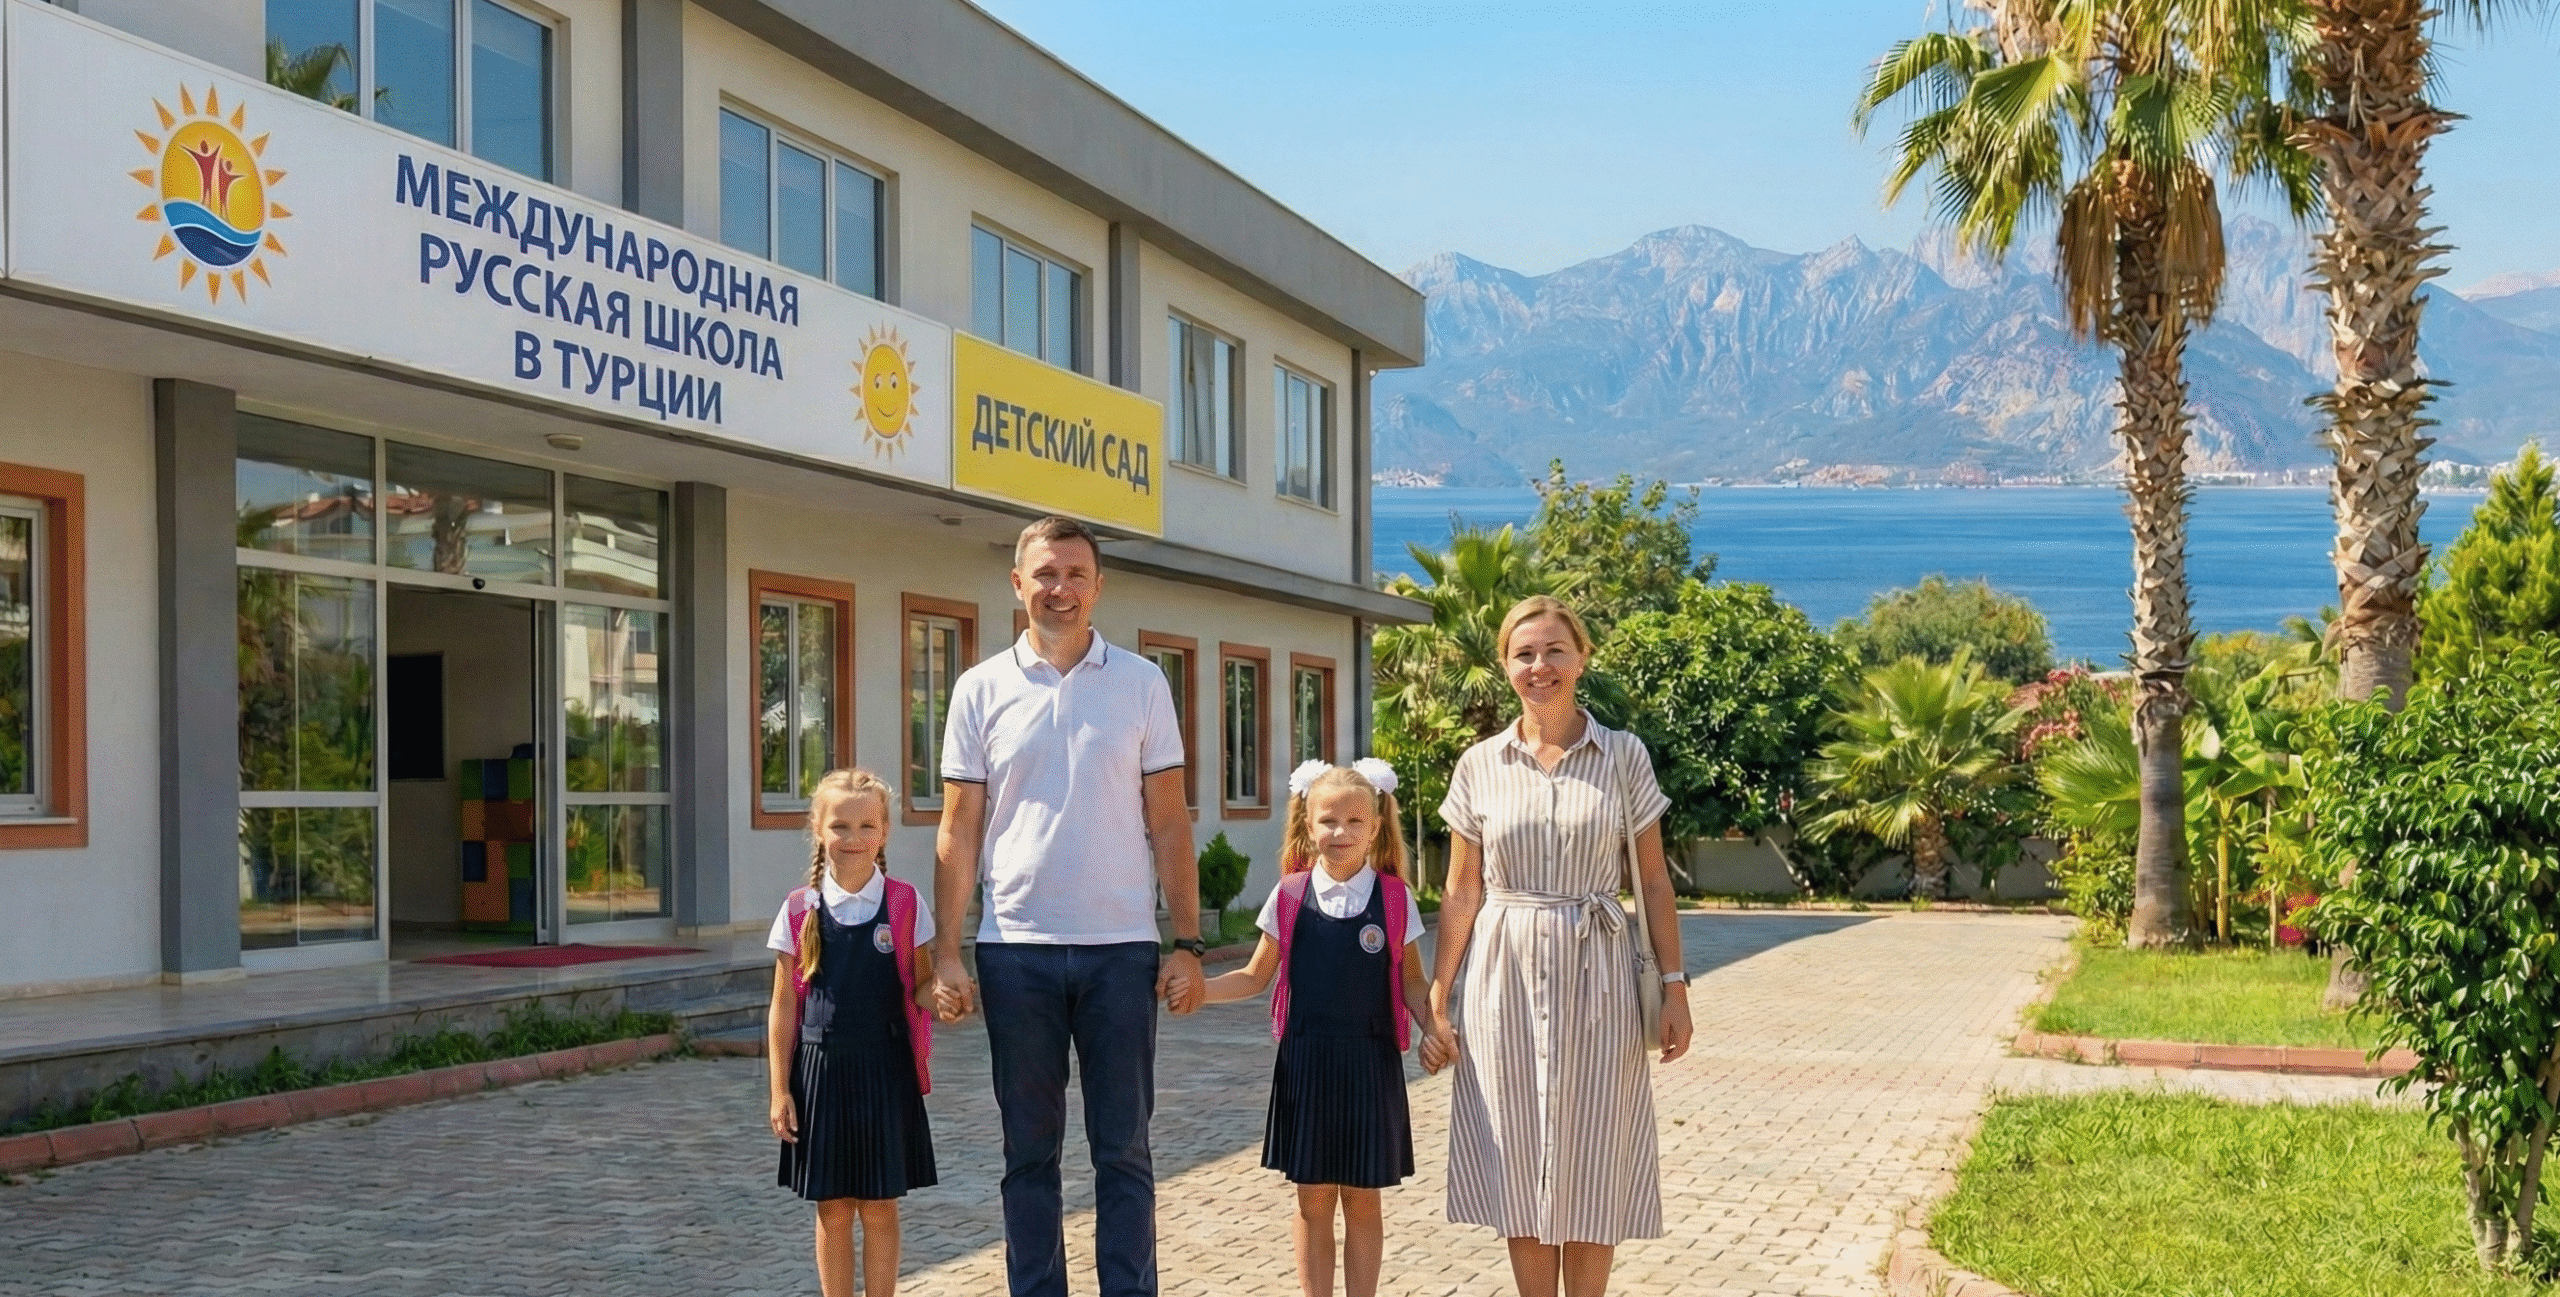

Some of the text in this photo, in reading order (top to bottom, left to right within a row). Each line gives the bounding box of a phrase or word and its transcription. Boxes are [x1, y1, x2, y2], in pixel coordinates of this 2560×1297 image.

[395, 154, 800, 327] МЕЖДУНАРОДНАЯ
[419, 232, 785, 381] РУССКАЯ ШКОЛА
[514, 330, 723, 424] В ТУРЦИИ
[971, 394, 1151, 496] ДЕТСКИЙ САД
